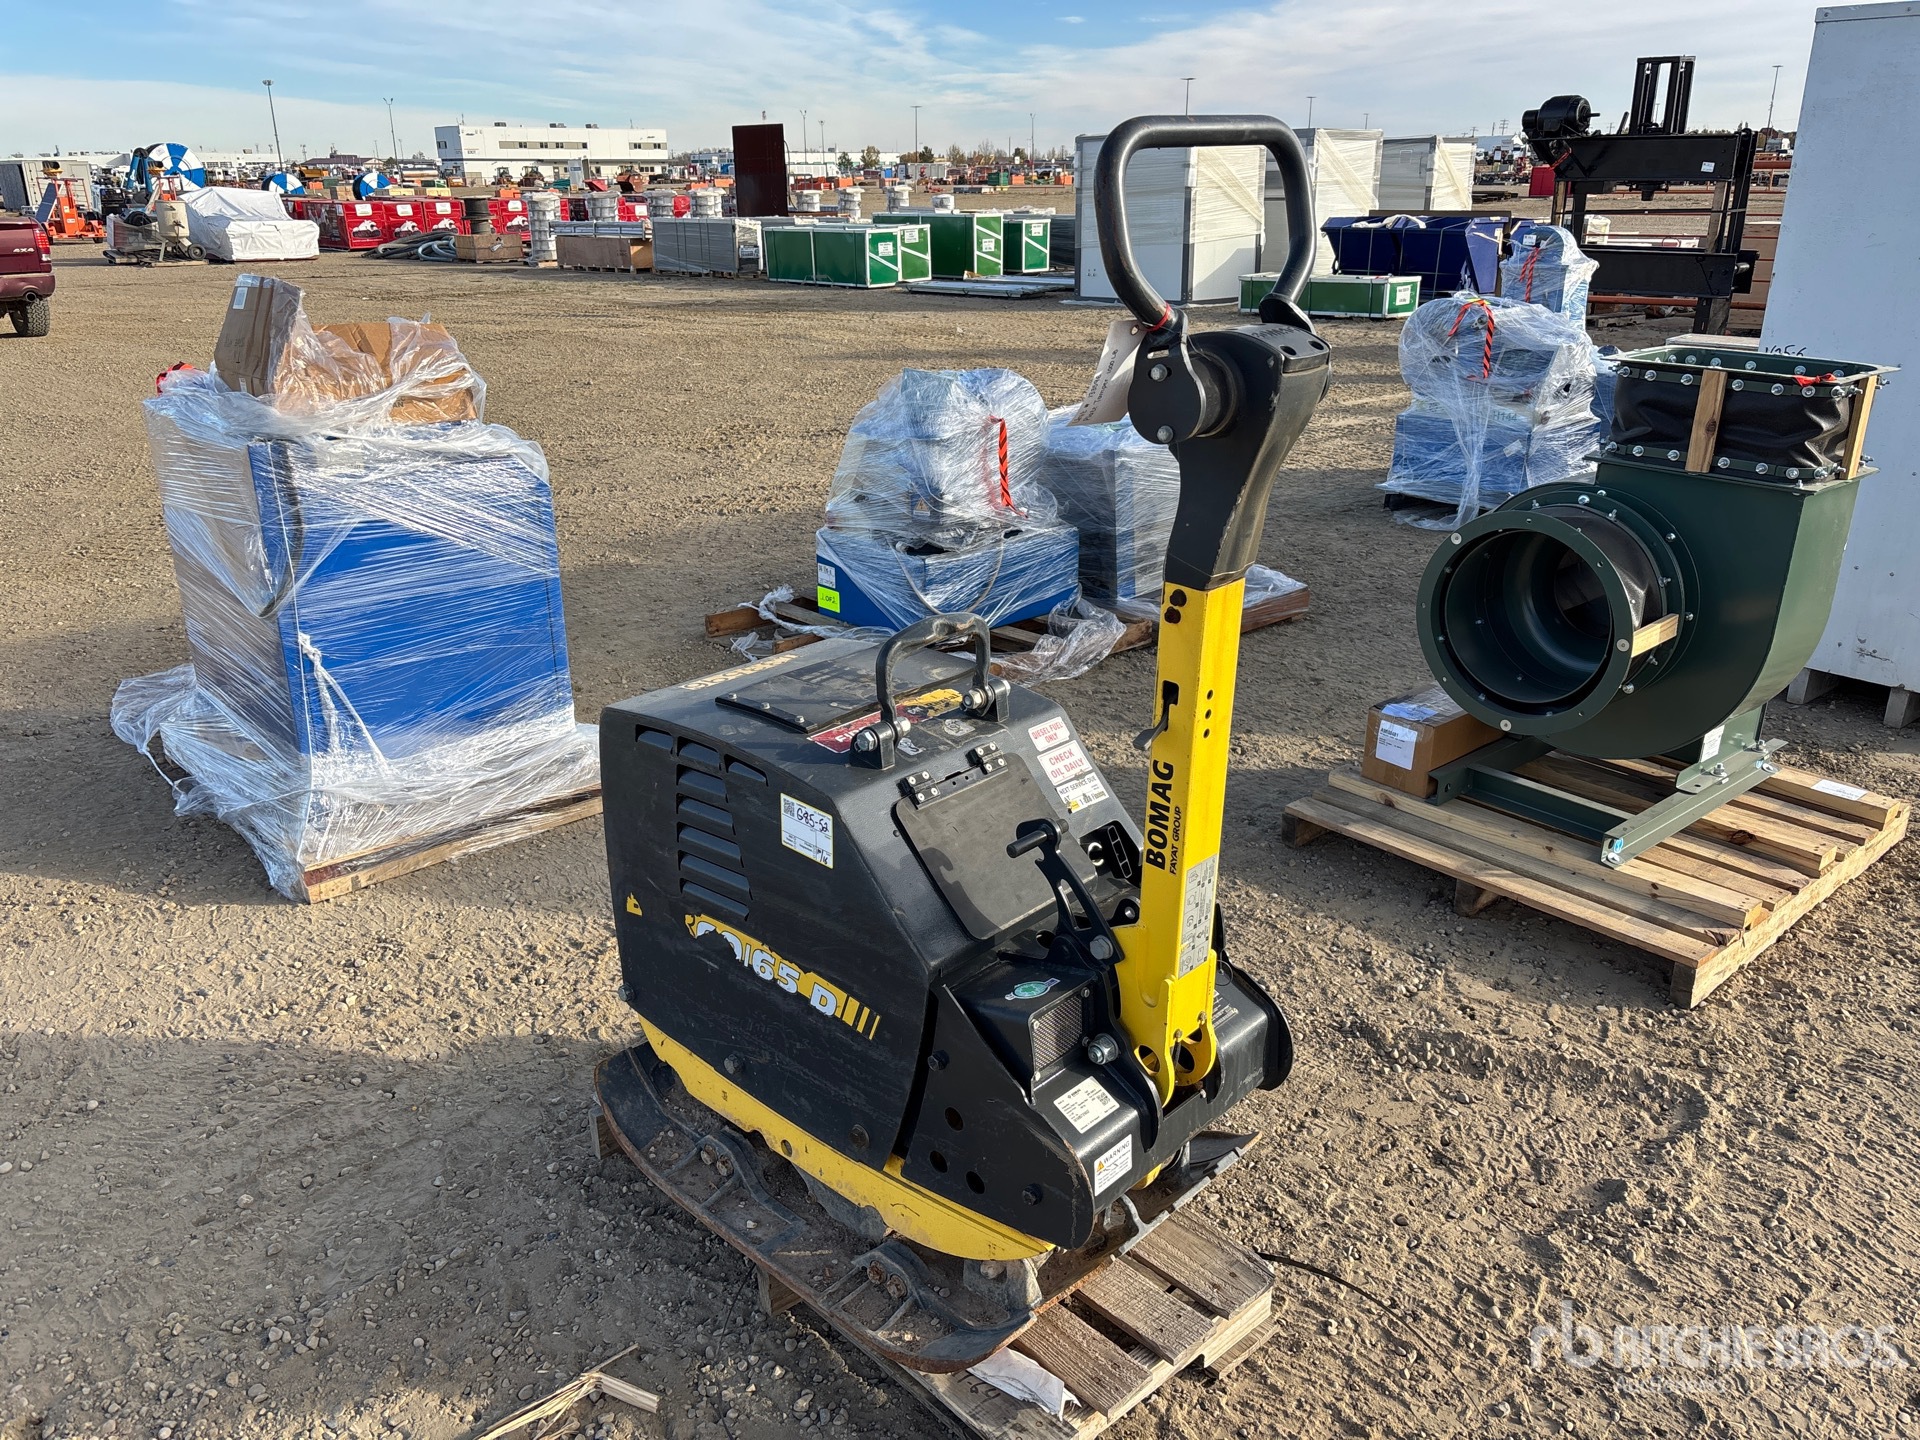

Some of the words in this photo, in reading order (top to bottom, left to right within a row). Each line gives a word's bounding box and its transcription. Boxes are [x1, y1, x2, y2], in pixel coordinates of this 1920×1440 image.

[1031, 725, 1052, 739] DIESEL
[1049, 721, 1063, 732] FUEL
[1044, 732, 1059, 743] ONLY
[1048, 748, 1075, 766] CHECK
[1050, 766, 1064, 778] OIL
[1064, 758, 1085, 772] DAILY
[1146, 759, 1174, 870] BOMAG
[1173, 806, 1182, 842] GROUP
[1169, 844, 1180, 875] FAYAT
[809, 982, 838, 1017] D
[1103, 1140, 1131, 1164] WARNING
